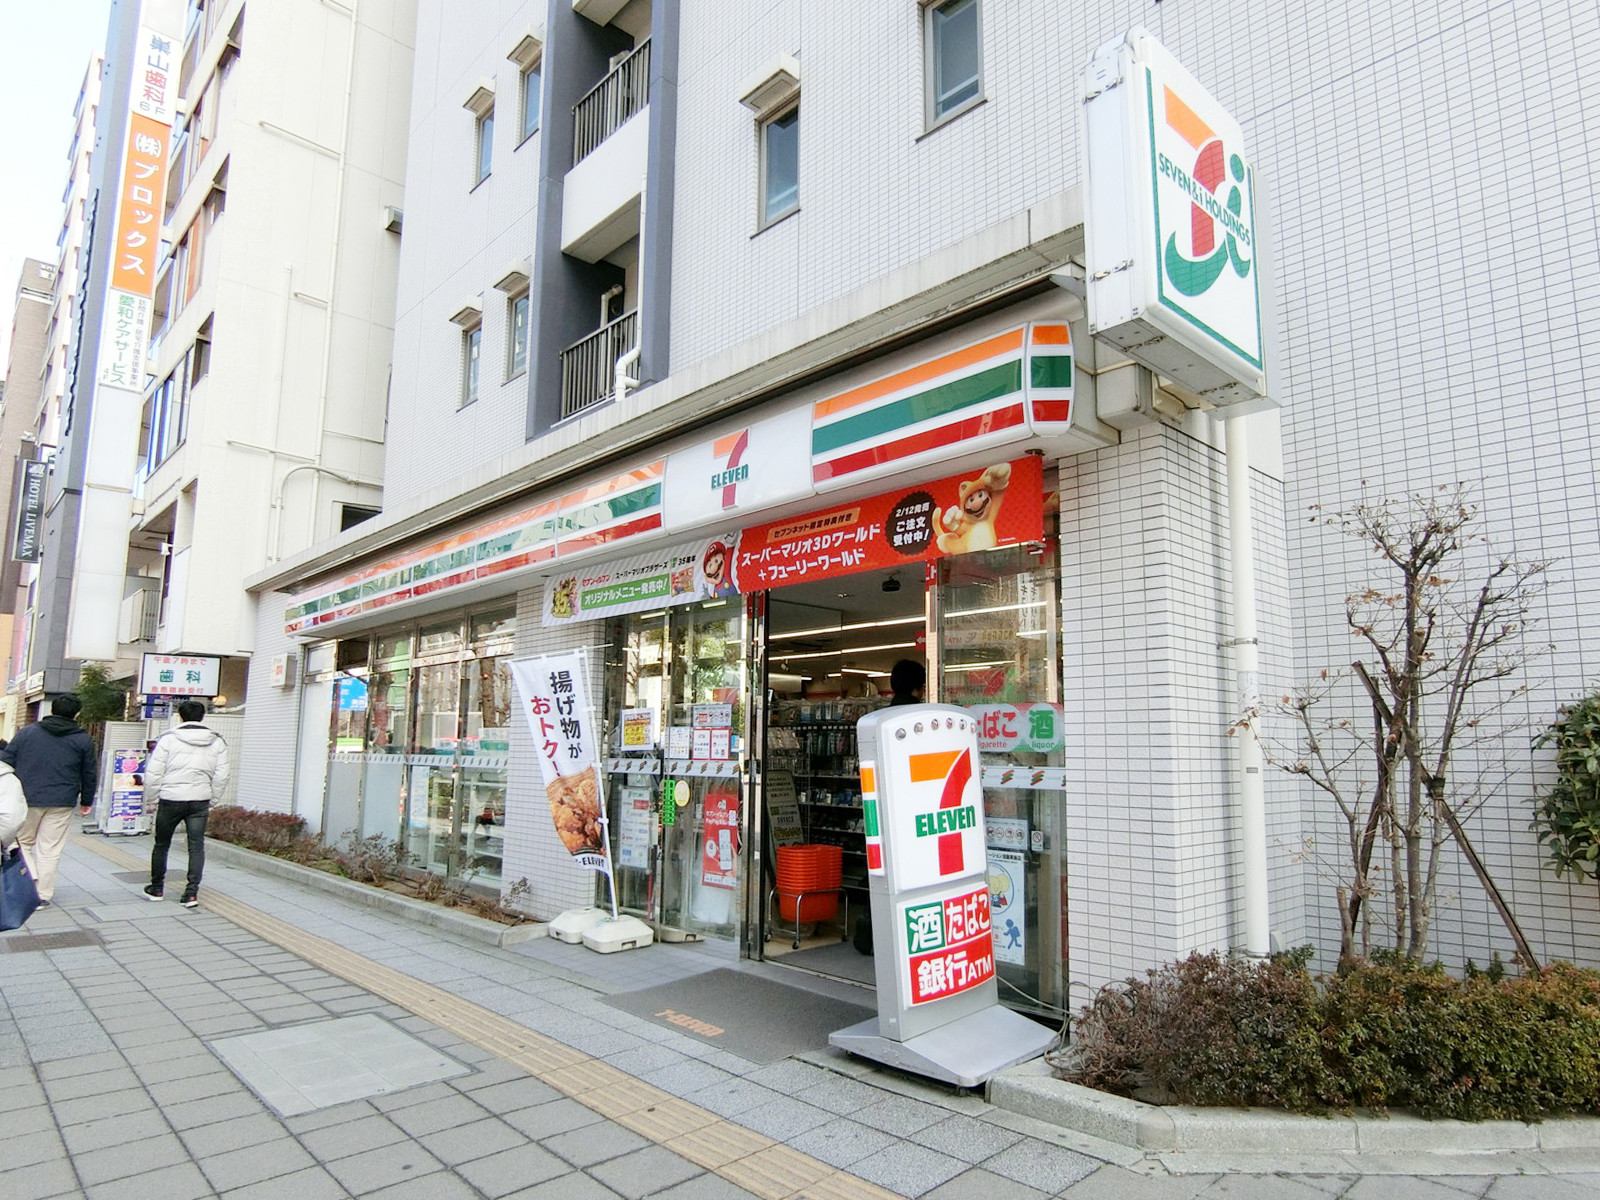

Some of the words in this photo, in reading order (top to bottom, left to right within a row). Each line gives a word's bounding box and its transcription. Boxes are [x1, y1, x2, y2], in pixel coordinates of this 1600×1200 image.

[1204, 191, 1251, 246] HOLDINGS
[27, 478, 41, 510] HOTEL
[895, 502, 930, 517] 2/12発売
[21, 512, 37, 557] LIVEMAX
[893, 529, 930, 546] 受付中!
[896, 516, 926, 532] ご注文
[741, 523, 881, 567] スーパーマリオ3Dワールド
[585, 577, 668, 605] オリジナルメニュー発売中!
[154, 656, 207, 666] 午後7時まで
[160, 669, 201, 684] 歯科
[549, 670, 582, 759] 揚げ物が
[1029, 709, 1054, 739] 酒
[1031, 741, 1055, 749] liquor
[908, 905, 943, 952] 酒
[945, 893, 990, 943] たばこ
[917, 950, 992, 997] 銀行ATM
